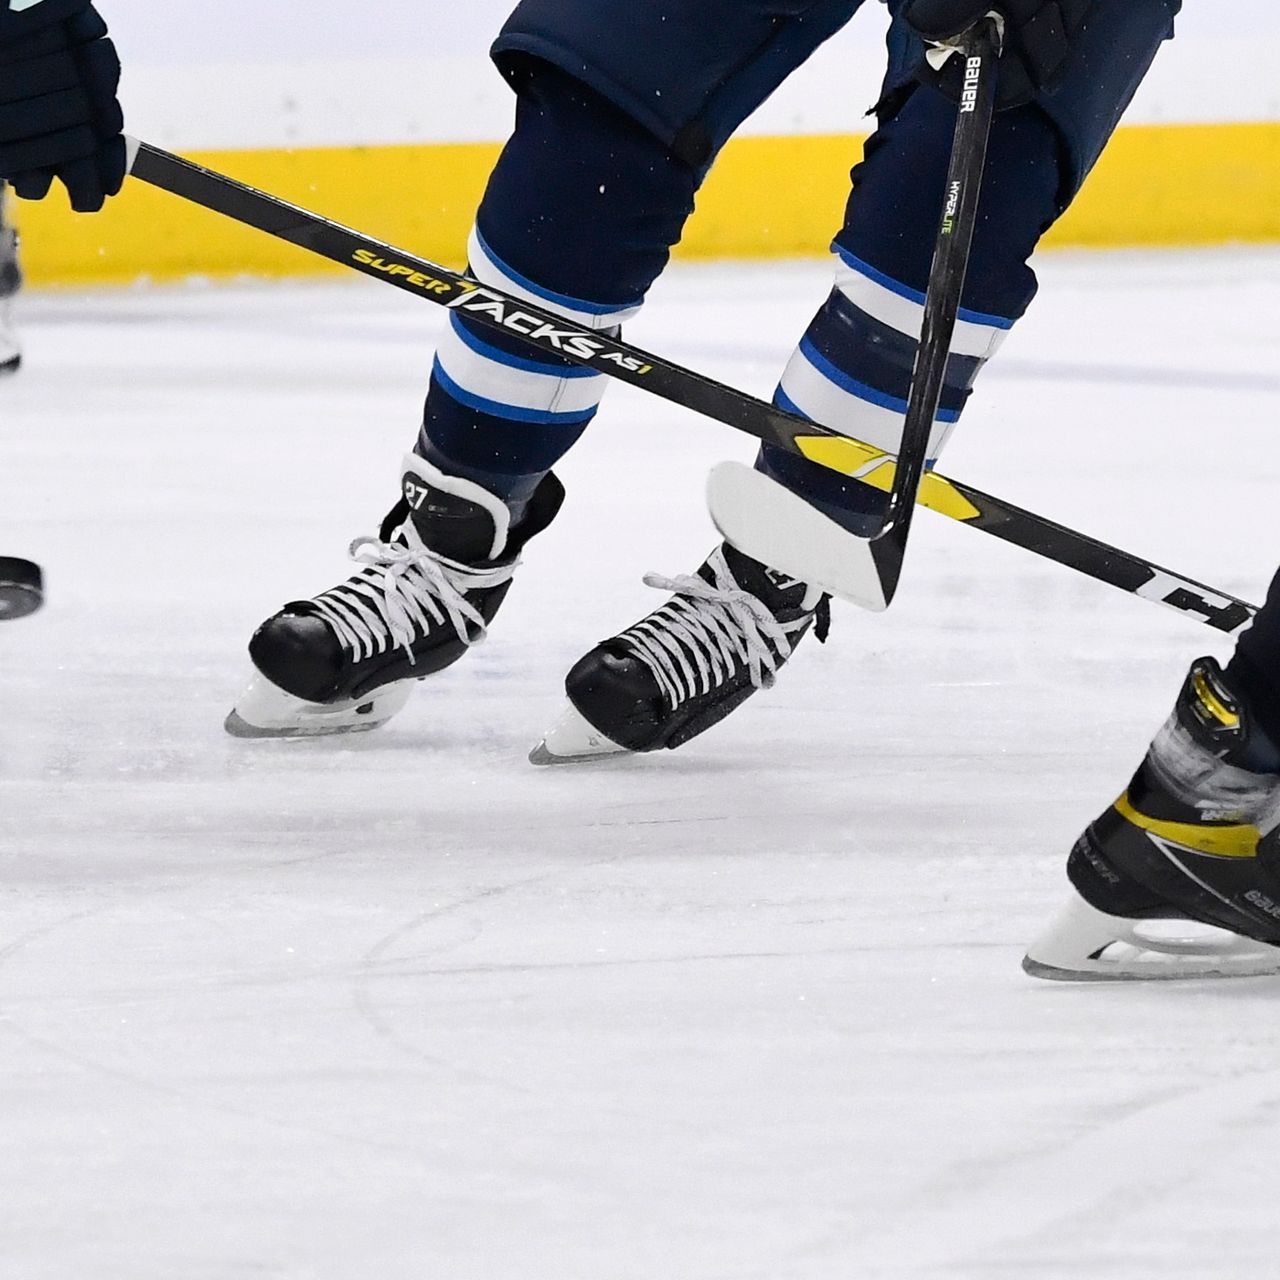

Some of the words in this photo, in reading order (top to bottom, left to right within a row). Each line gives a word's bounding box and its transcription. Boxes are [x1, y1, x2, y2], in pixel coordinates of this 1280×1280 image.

[941, 180, 961, 235] HYPERLITE
[351, 248, 452, 295] SUPER
[446, 281, 605, 360] TACKS
[599, 351, 654, 376] AS1
[404, 481, 429, 511] 27
